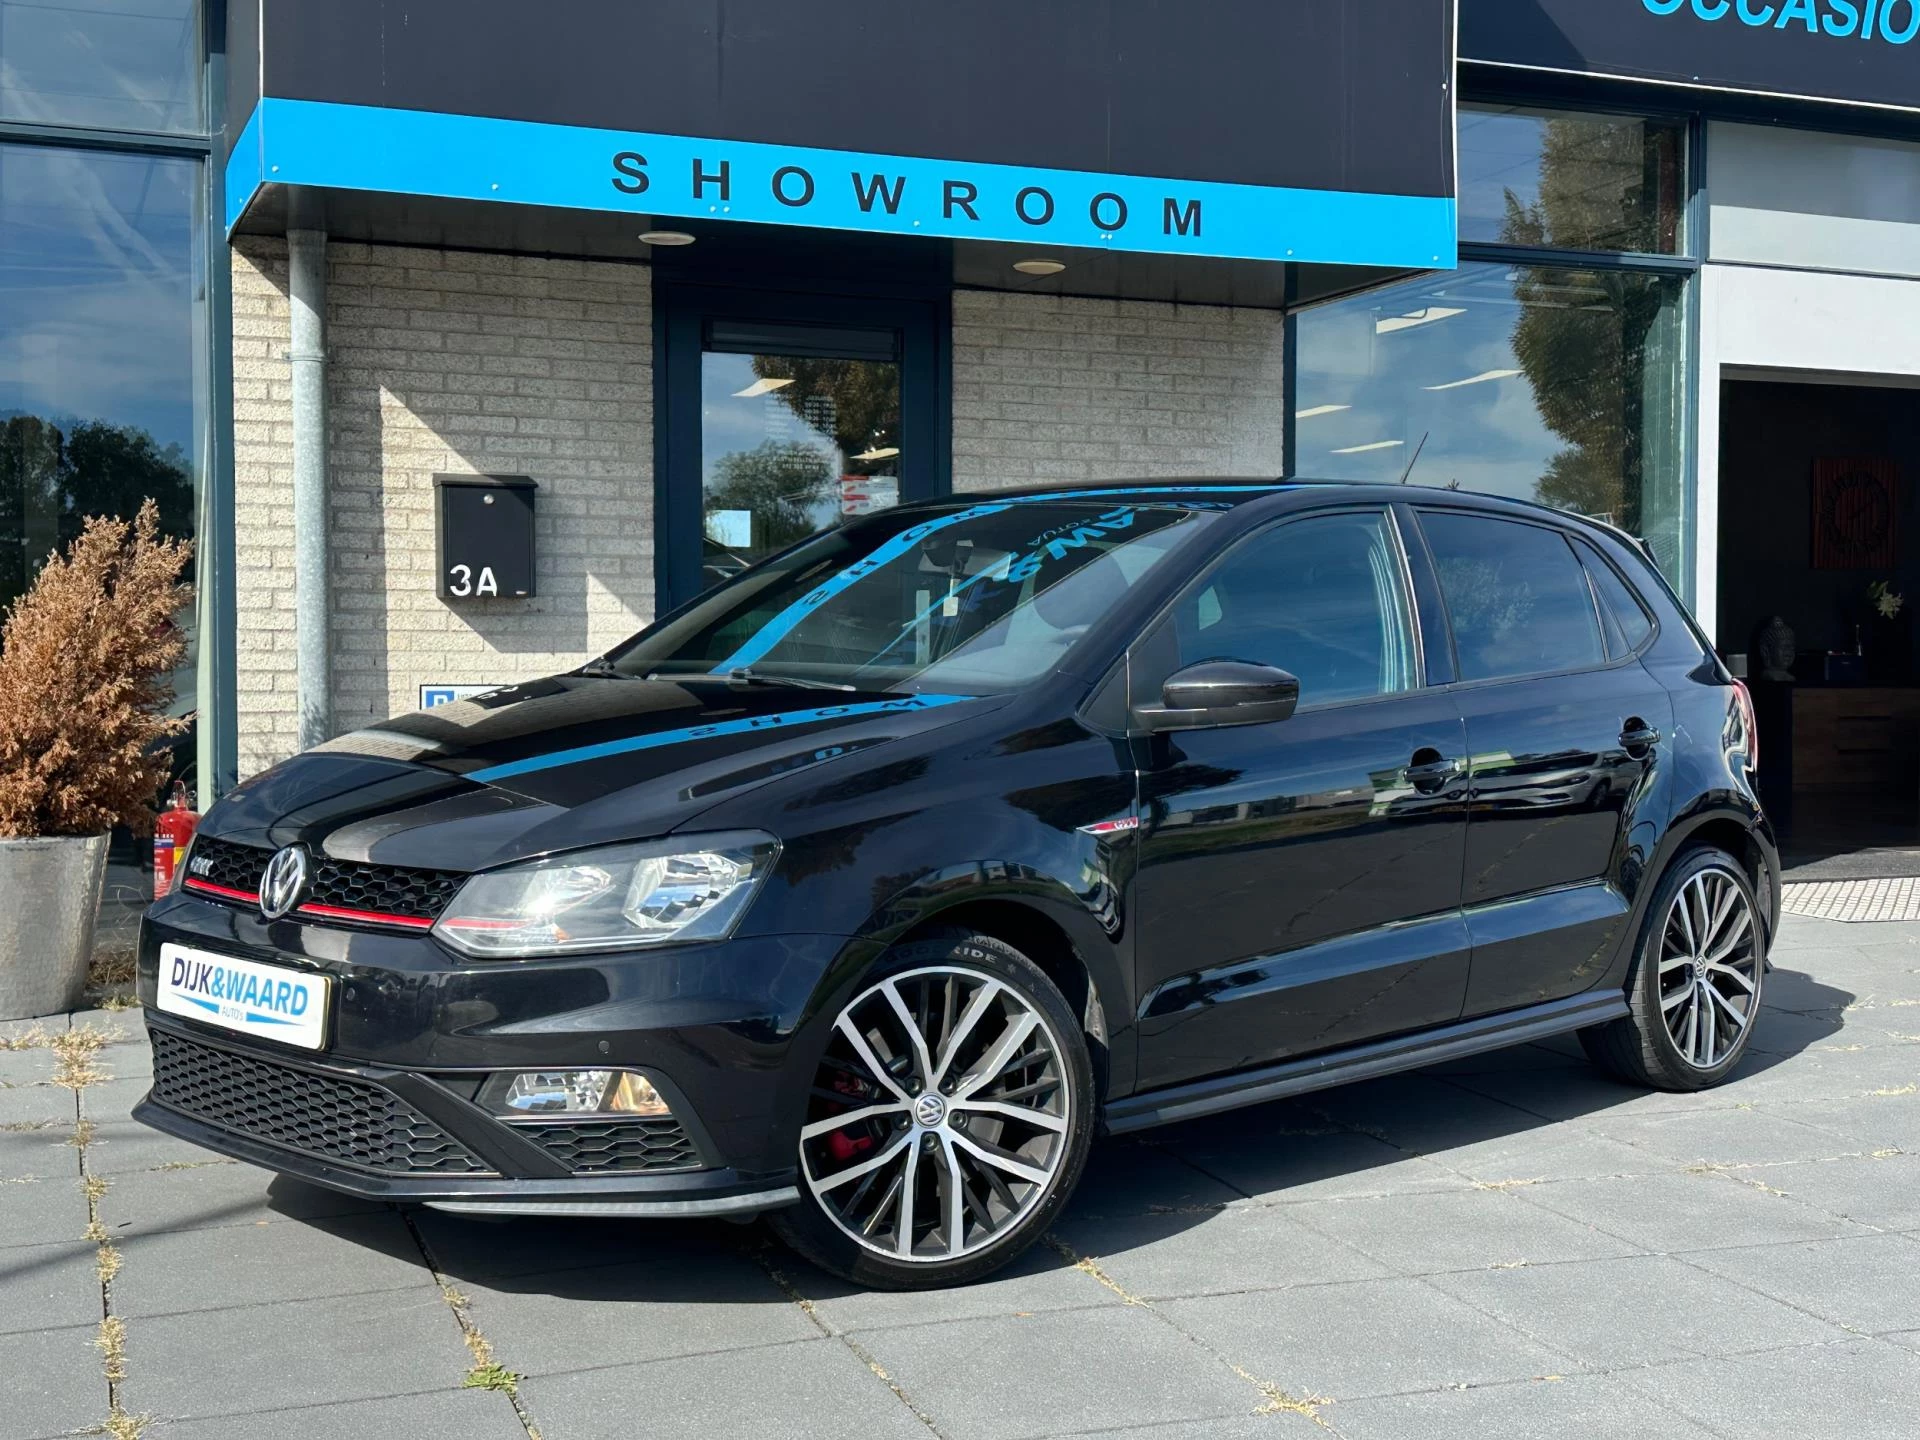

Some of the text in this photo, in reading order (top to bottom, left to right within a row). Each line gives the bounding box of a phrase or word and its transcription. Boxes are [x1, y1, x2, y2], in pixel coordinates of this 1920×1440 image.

[611, 151, 1202, 237] SHOWROOM
[450, 564, 497, 596] 3A
[171, 957, 308, 1016] DIJK&WAARD
